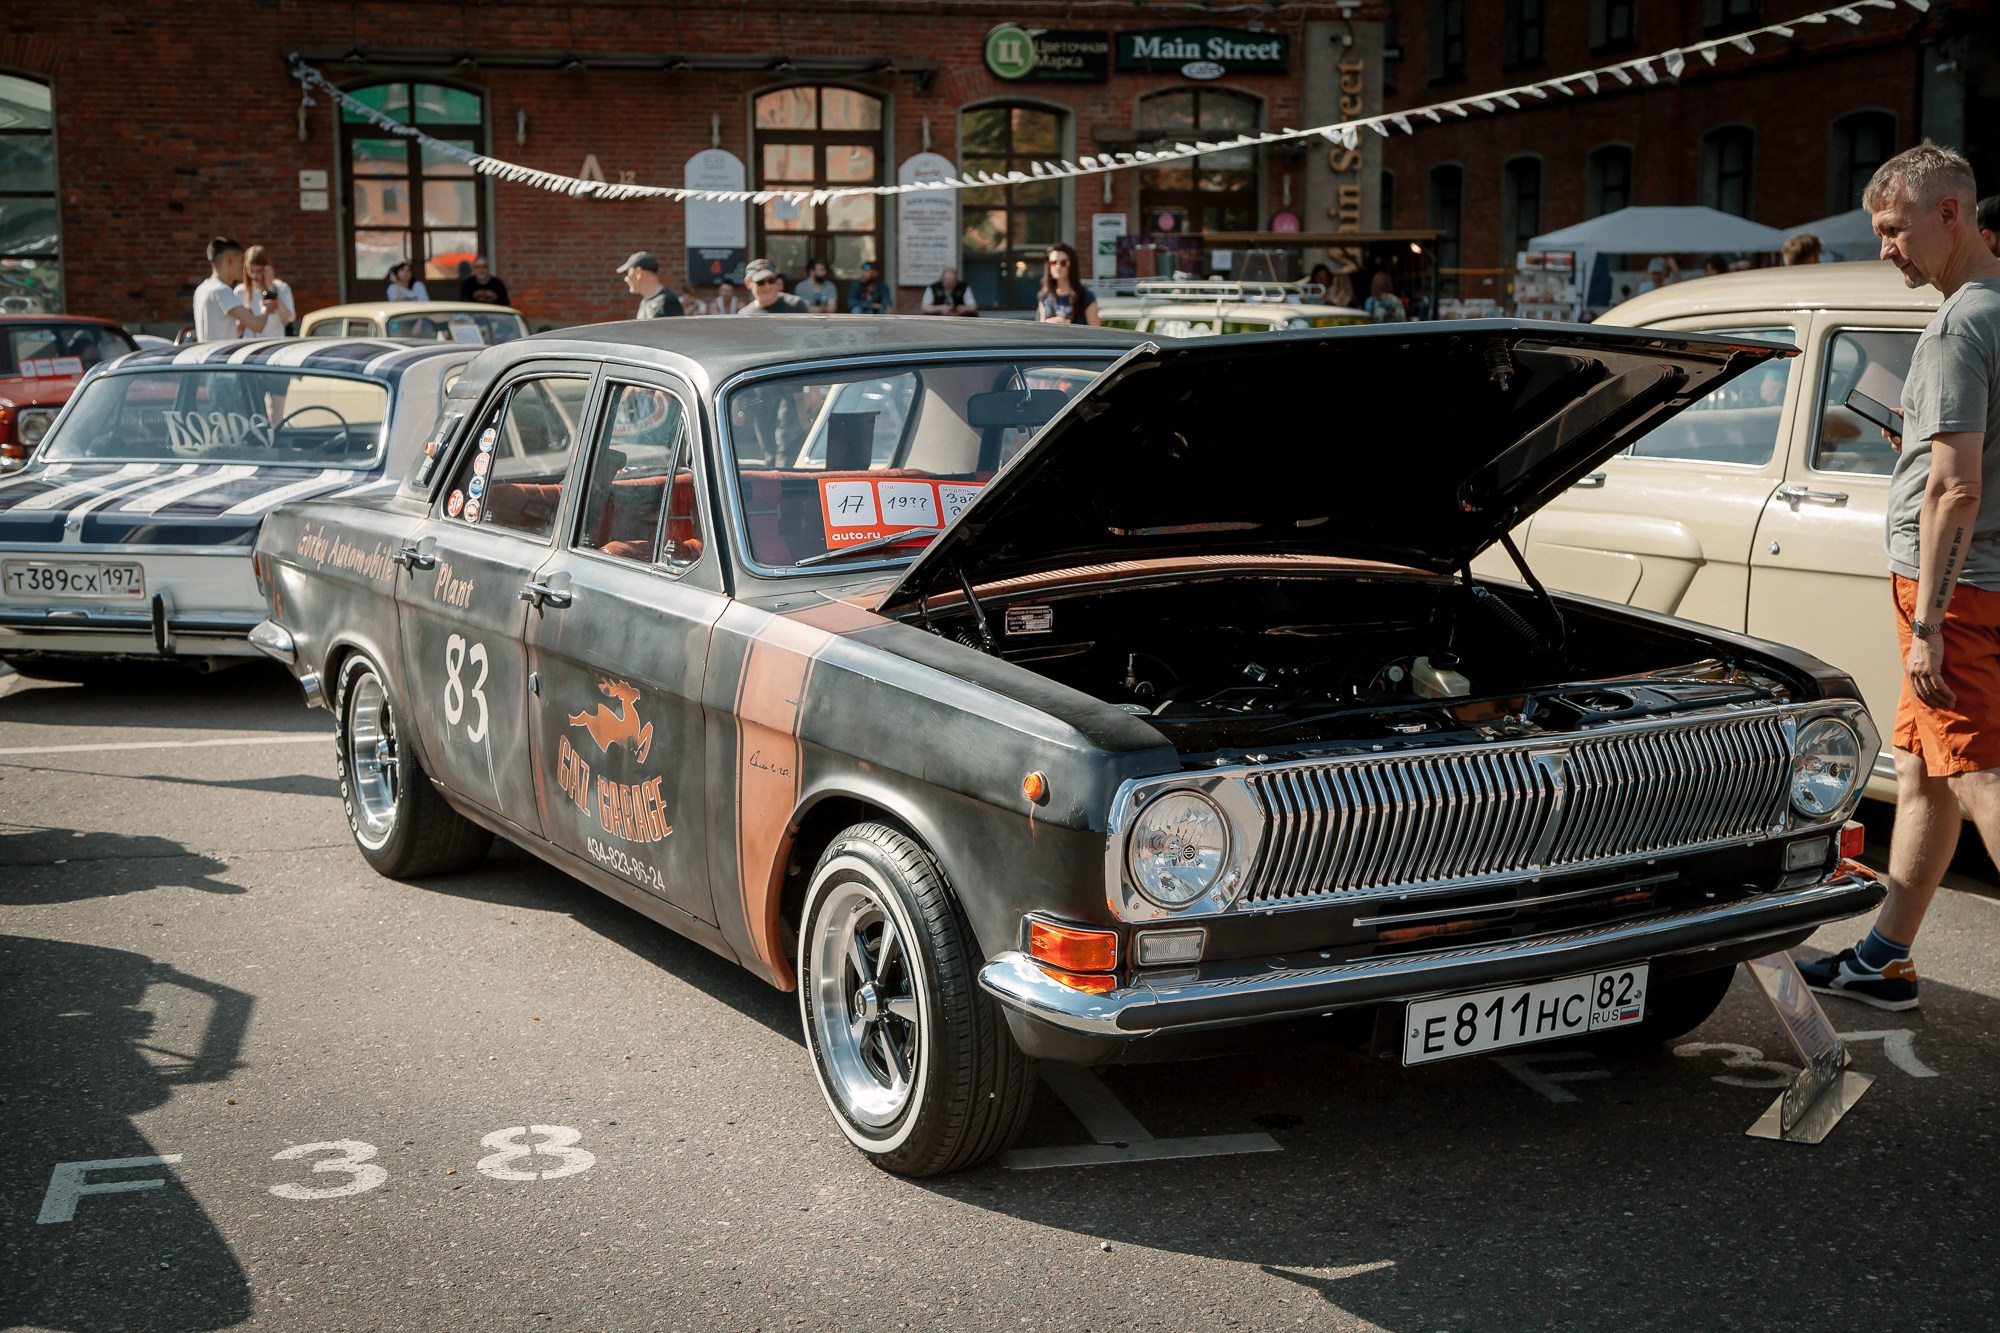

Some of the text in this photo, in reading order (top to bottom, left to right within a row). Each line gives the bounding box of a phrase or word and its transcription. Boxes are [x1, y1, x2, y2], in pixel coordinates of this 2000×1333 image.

[1132, 36, 1281, 60] Main Street
[838, 495, 865, 514] 17
[887, 496, 927, 511] 19??
[831, 531, 881, 541] auto.ru
[103, 568, 134, 586] 197
[433, 561, 475, 609] Plant
[443, 633, 489, 744] 83
[557, 734, 674, 844] GAZ GARAGE
[1596, 971, 1635, 1010] 82
[1591, 1008, 1619, 1025] RUS
